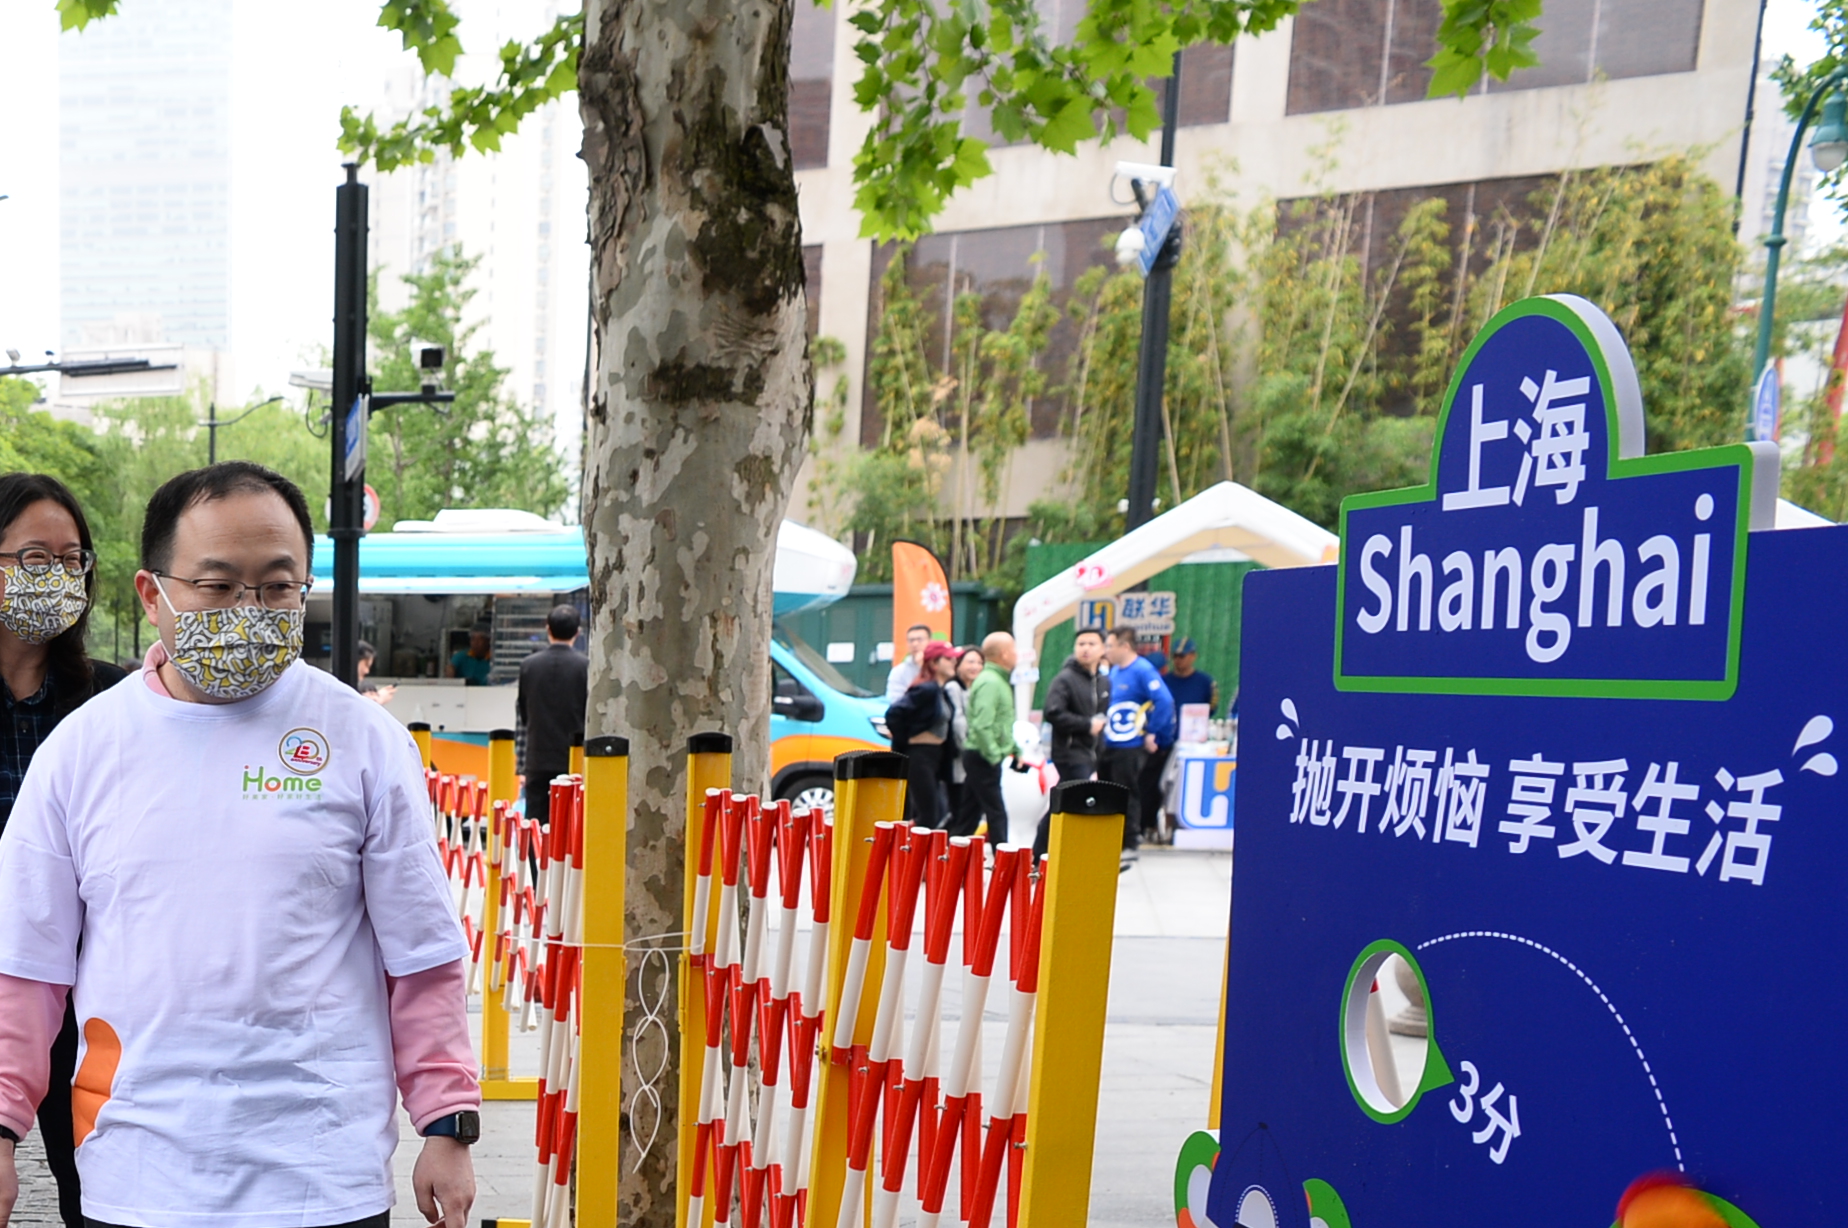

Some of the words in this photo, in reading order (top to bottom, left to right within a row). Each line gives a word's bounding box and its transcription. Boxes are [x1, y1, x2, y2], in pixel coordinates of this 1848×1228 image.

[1442, 369, 1591, 512] 上海
[1356, 493, 1714, 663] Shanghai
[243, 765, 322, 792] Home
[1290, 738, 1490, 848] 抛开烦恼
[1498, 752, 1784, 886] 享受生活
[1449, 1060, 1522, 1164] 3分
